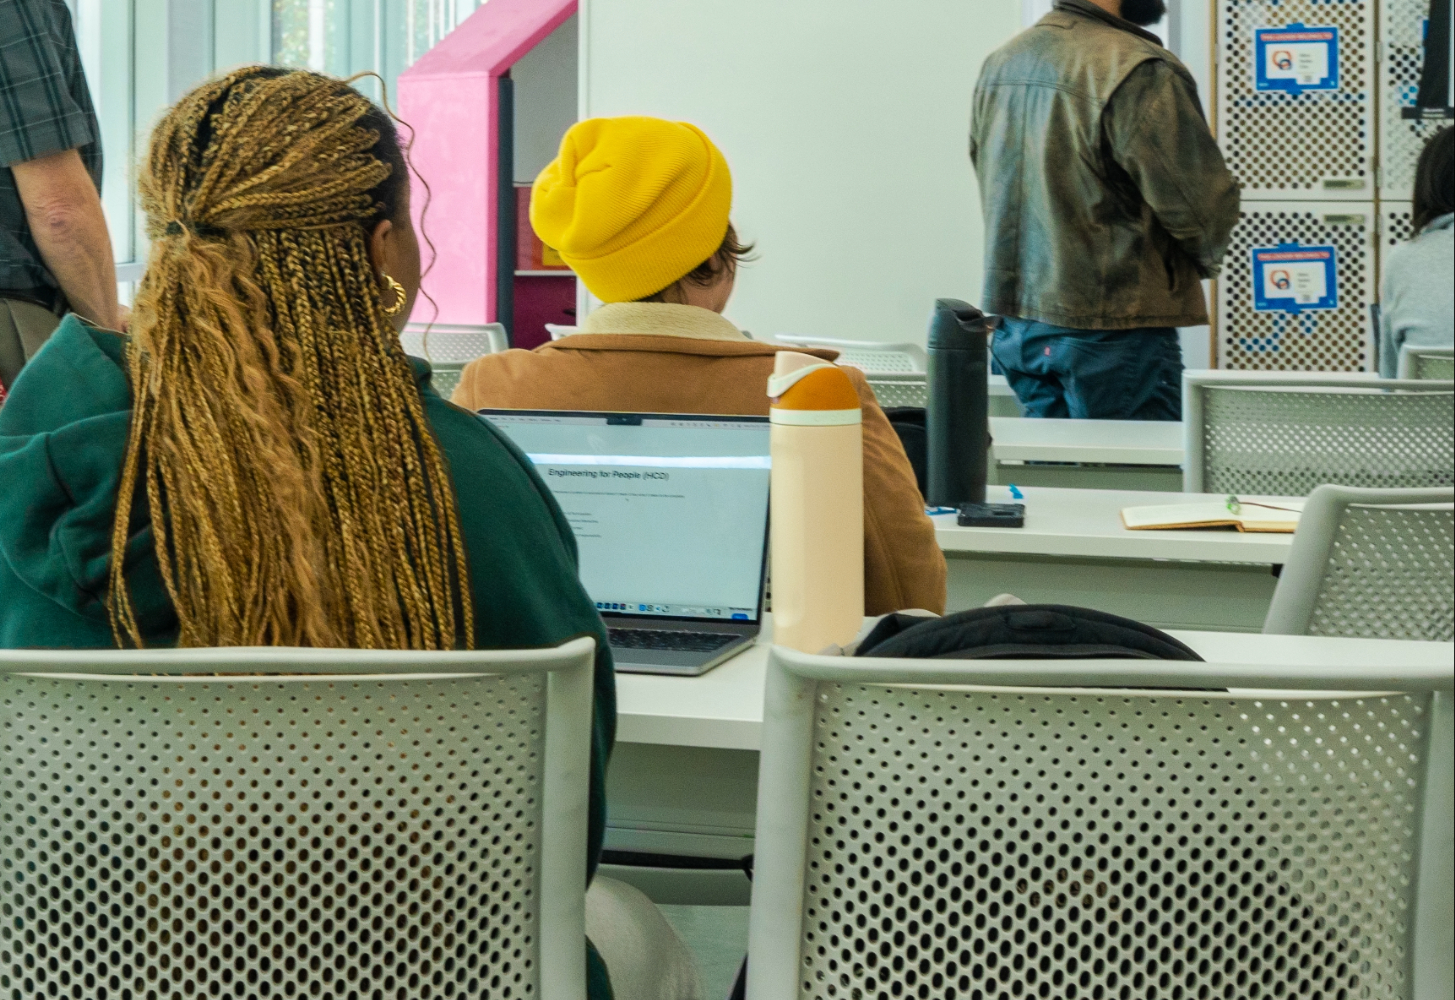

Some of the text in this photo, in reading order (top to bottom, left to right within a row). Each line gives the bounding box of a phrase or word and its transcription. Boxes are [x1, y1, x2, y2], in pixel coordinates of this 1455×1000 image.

[548, 469, 597, 479] Engineering
[599, 470, 611, 478] for
[612, 471, 641, 480] People
